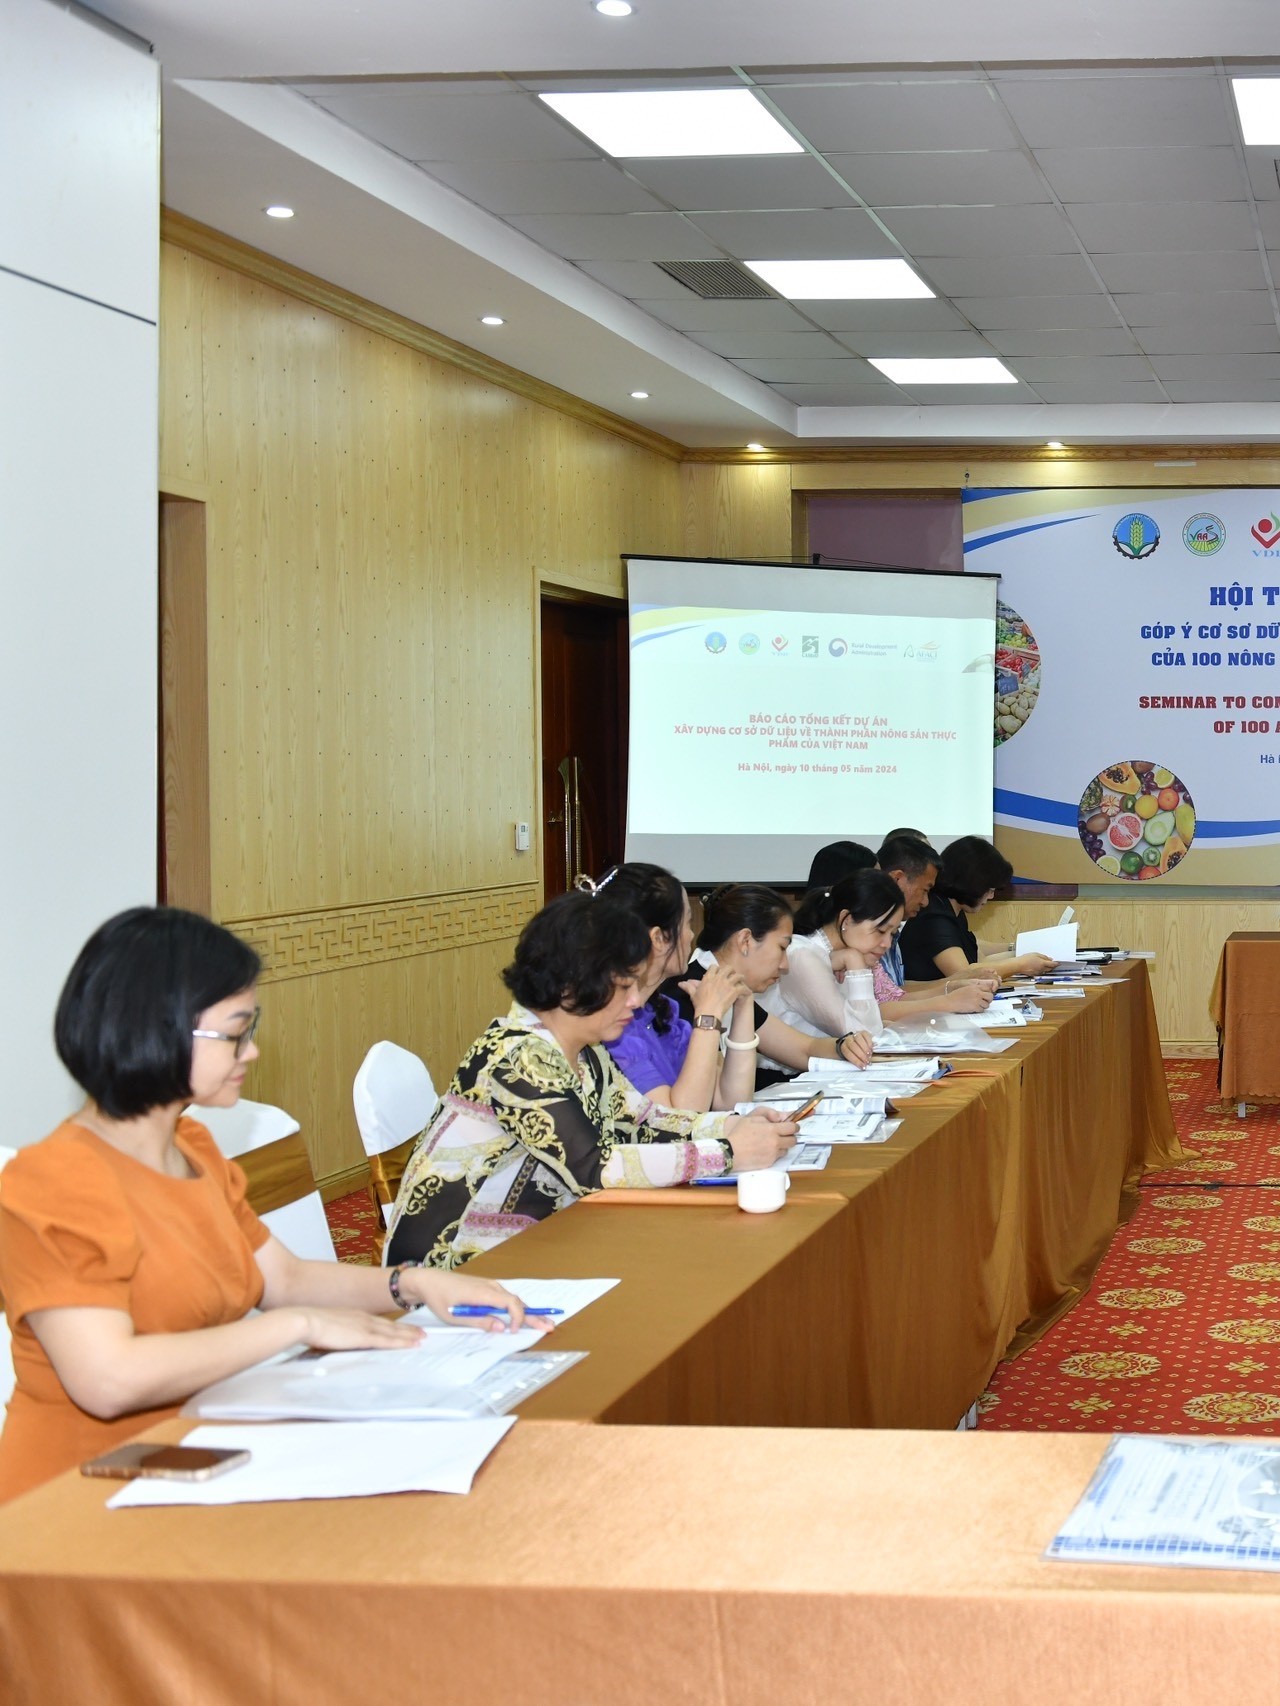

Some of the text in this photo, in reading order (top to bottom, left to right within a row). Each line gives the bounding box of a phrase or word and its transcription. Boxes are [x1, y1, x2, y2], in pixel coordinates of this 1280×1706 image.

[1209, 582, 1254, 611] HỘI
[1140, 621, 1175, 639] GÓP
[1181, 621, 1193, 639] Ý
[1198, 623, 1223, 639] CƠ
[1256, 622, 1280, 639] DỮ
[1151, 647, 1186, 666] CỦA
[1192, 652, 1222, 666] 100
[1228, 649, 1276, 666] NÔNG
[1139, 696, 1217, 709] SEMINAR
[1223, 696, 1246, 709] TO
[749, 712, 772, 724] BÁO
[775, 713, 797, 724] CÁO
[832, 713, 851, 725] KẾT
[854, 717, 870, 729] DỰ
[872, 715, 888, 727] ÁN
[1213, 720, 1235, 734] OF
[1241, 720, 1270, 734] 100
[674, 723, 694, 734] XÂY
[696, 725, 726, 737] DỰNG
[728, 726, 743, 735] CƠ
[744, 725, 758, 736] SỞ
[760, 725, 775, 736] DỮ
[777, 726, 797, 738] LIỆU
[800, 726, 811, 737] VỀ
[814, 727, 848, 737] THÀNH
[851, 727, 878, 738] PHẦN
[880, 729, 908, 739] NÔNG
[931, 731, 957, 741] THỰC
[800, 738, 821, 749] CỦA
[823, 739, 843, 750] VIỆT
[845, 741, 868, 750] NAM
[1260, 754, 1275, 764] Hà
[738, 763, 897, 774] Hà Nội, ngày 10 tháng 05 năm 2024
